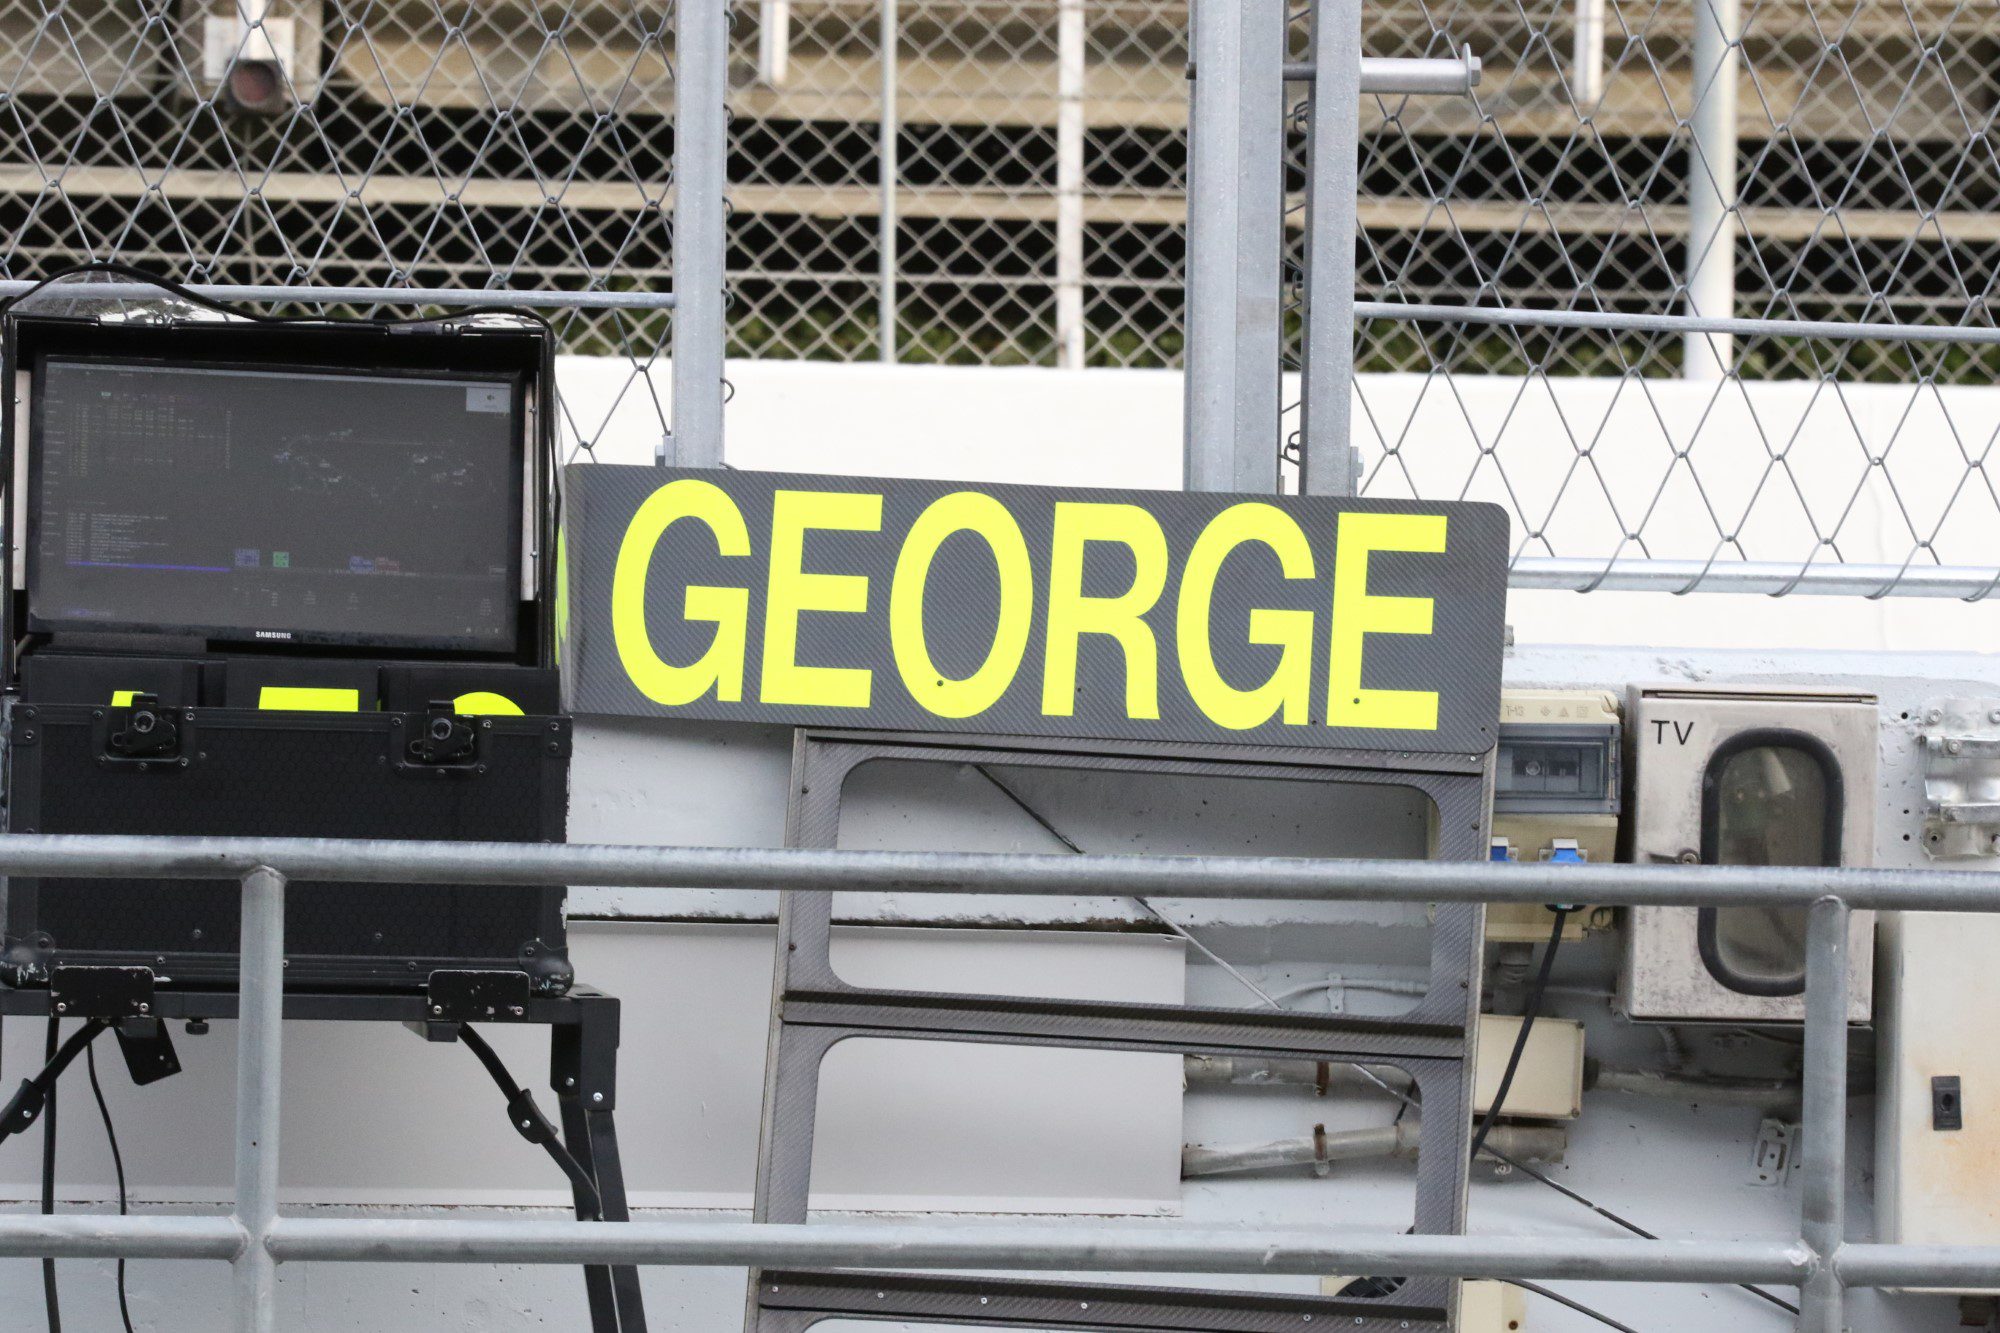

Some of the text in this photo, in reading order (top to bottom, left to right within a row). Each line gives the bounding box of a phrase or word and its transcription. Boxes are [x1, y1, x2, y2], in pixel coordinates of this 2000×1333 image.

[611, 479, 1448, 731] GEORGE
[255, 630, 292, 639] SAMSUNG
[1650, 719, 1695, 746] TV
